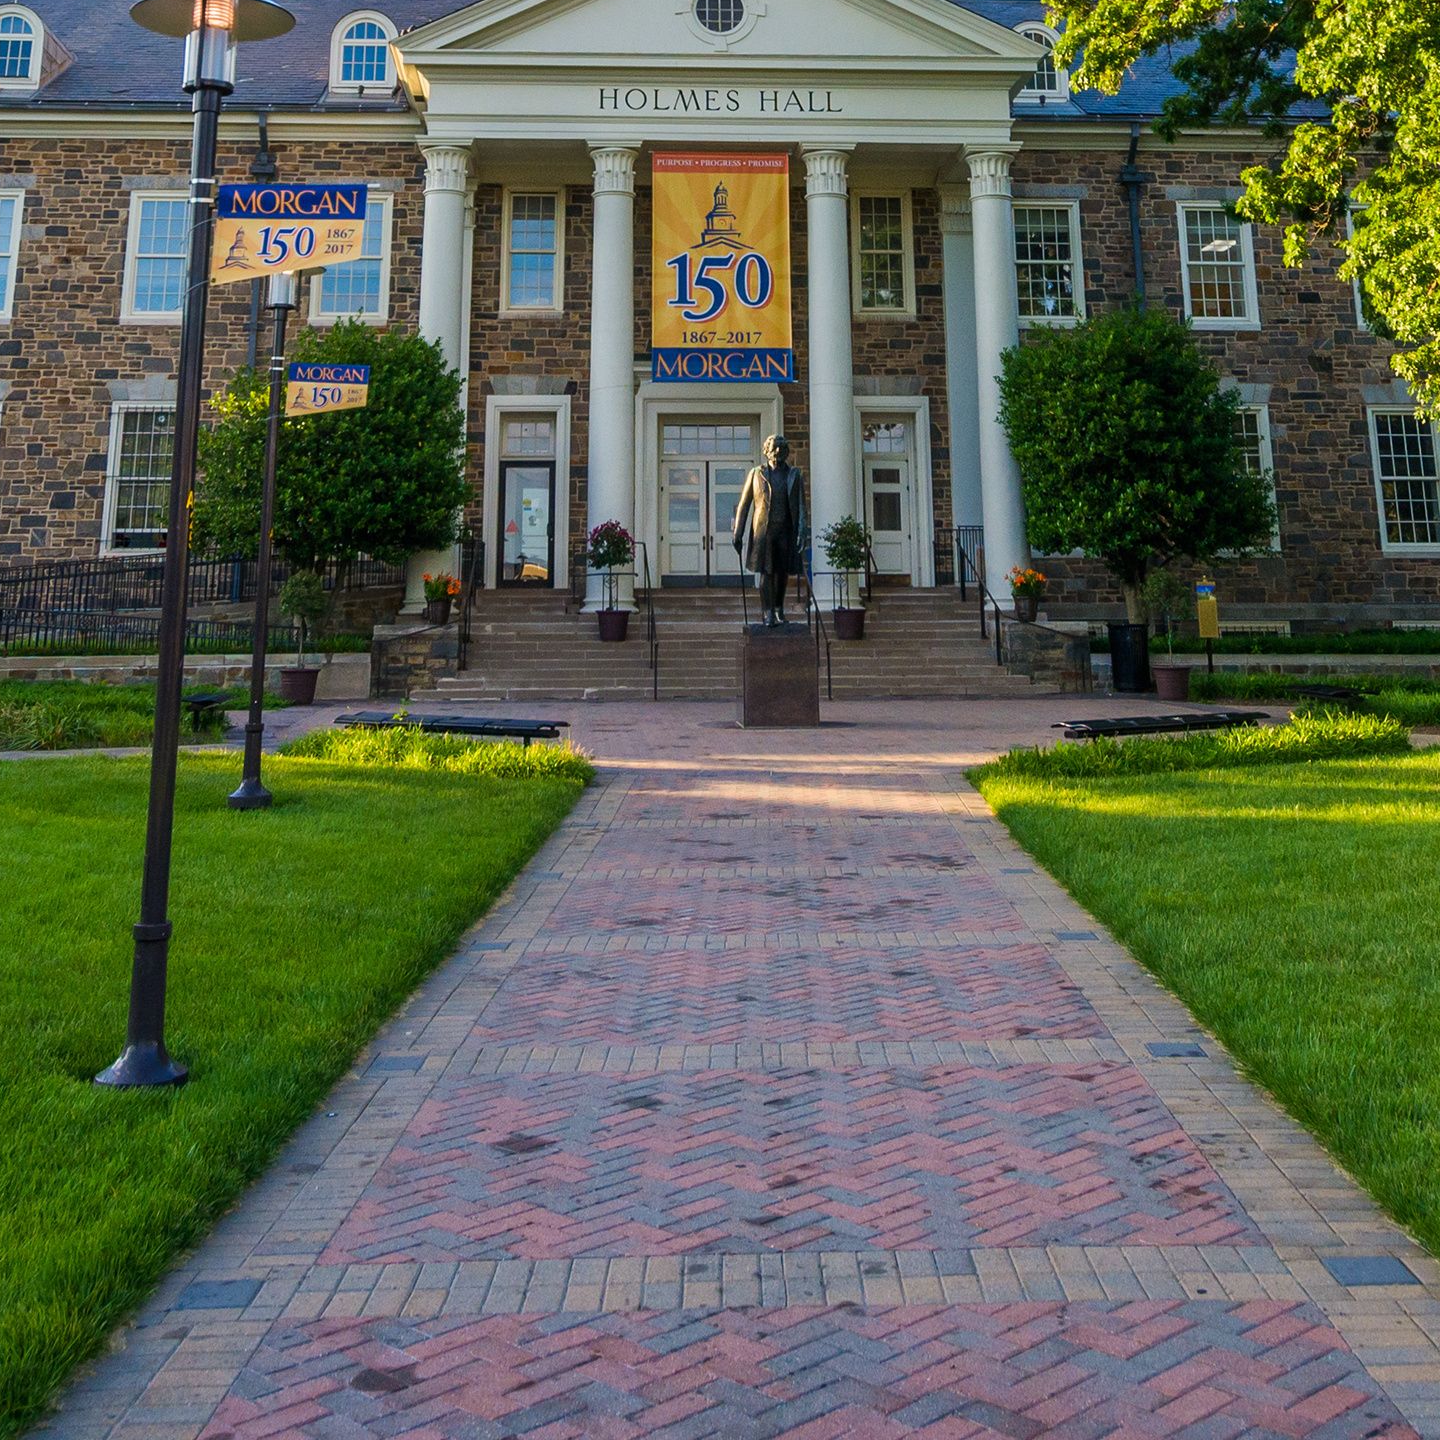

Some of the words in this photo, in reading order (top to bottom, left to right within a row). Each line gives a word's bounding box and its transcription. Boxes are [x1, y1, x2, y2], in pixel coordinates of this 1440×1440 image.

[599, 88, 740, 112] HOLMES
[759, 90, 843, 113] HALL
[700, 159, 742, 167] PROGRESS
[231, 189, 359, 215] MORGAN
[327, 228, 356, 239] 1867
[256, 225, 317, 267] 150
[324, 244, 353, 254] 2017
[665, 252, 775, 324] 150
[296, 366, 365, 382] MORGAN
[655, 352, 789, 378] MORGAN
[311, 386, 342, 409] 150
